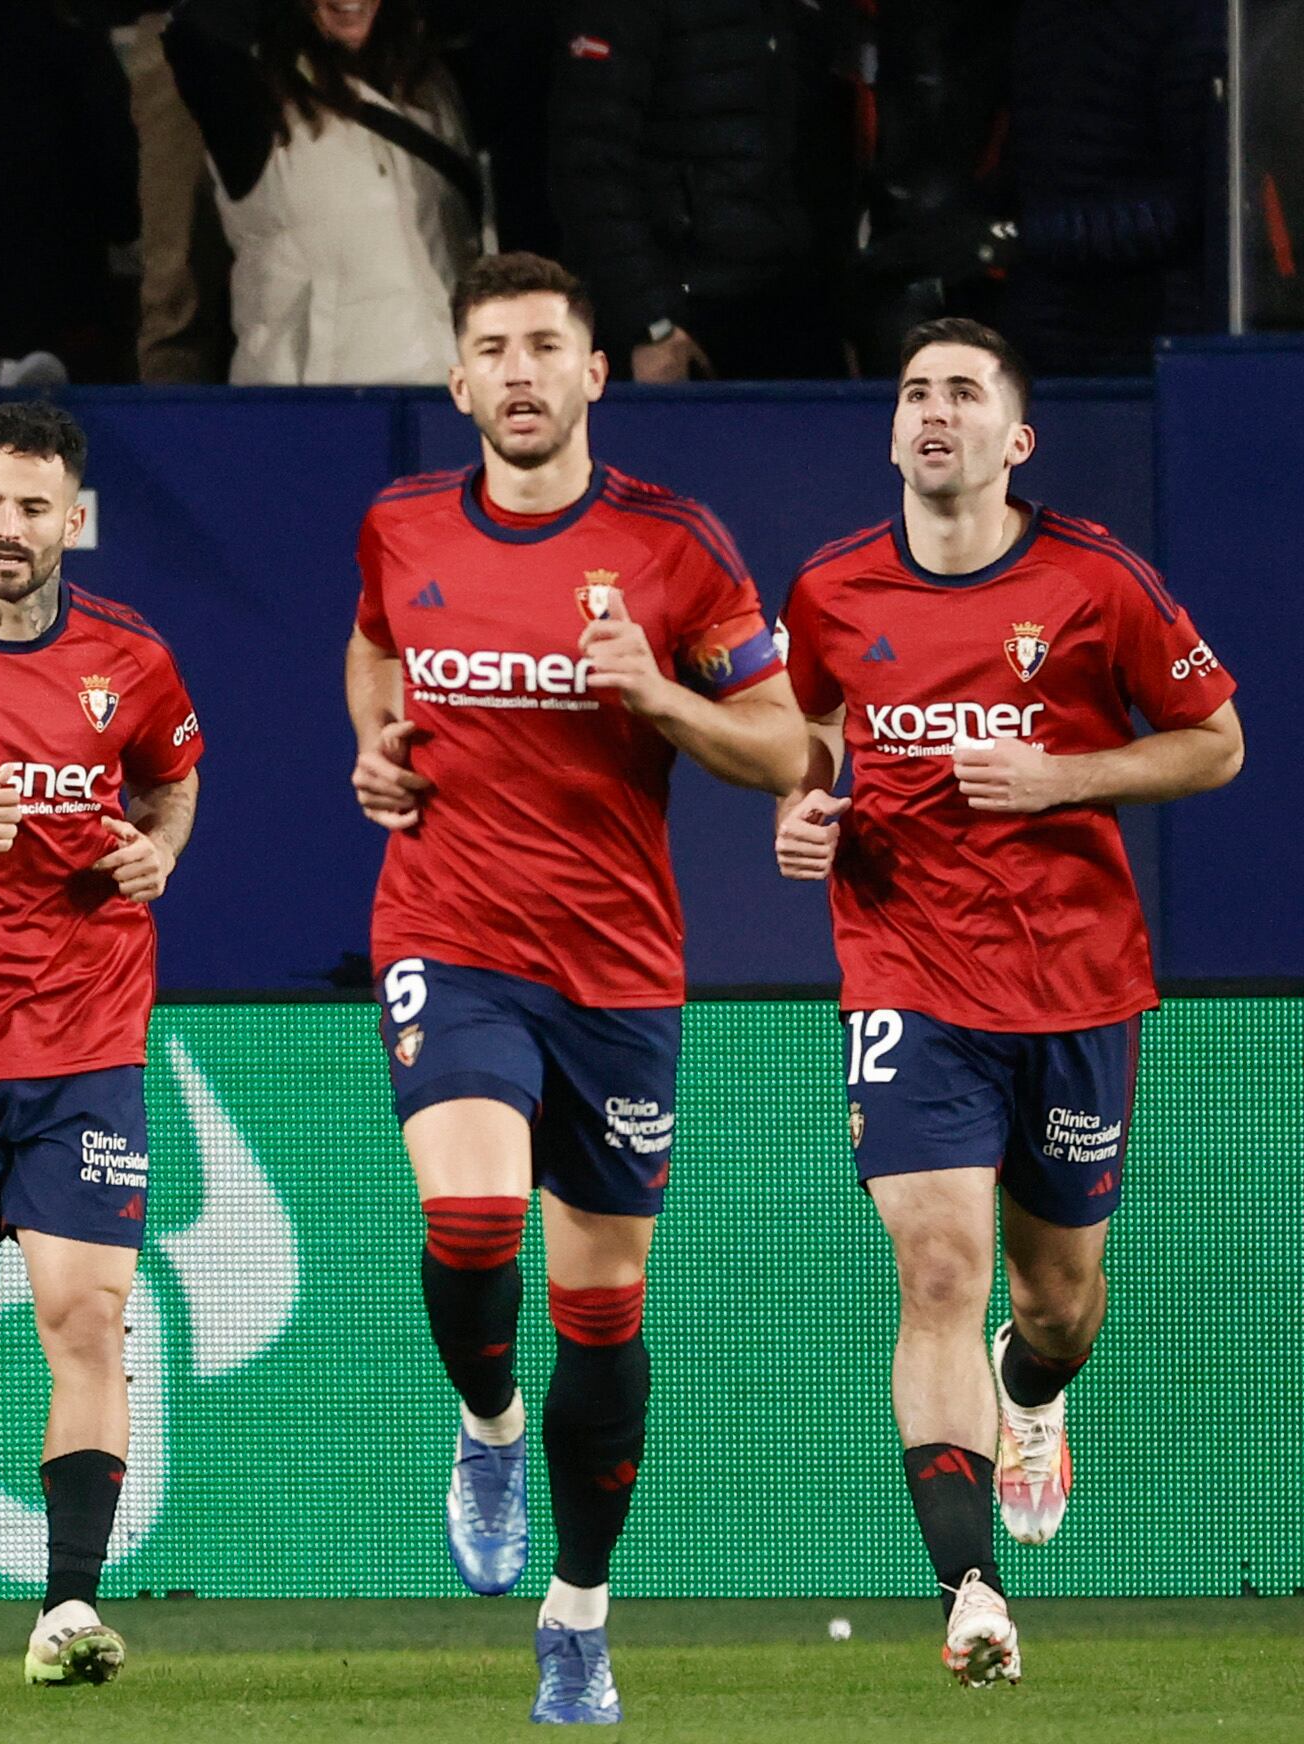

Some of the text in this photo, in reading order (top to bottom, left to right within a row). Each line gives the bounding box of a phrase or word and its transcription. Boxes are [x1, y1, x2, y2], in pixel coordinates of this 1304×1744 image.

[866, 701, 1044, 741] kosner
[384, 957, 428, 1024] 5
[847, 1008, 904, 1086] 12
[1042, 1141, 1119, 1163] de Navarra
[80, 1164, 102, 1183] de
